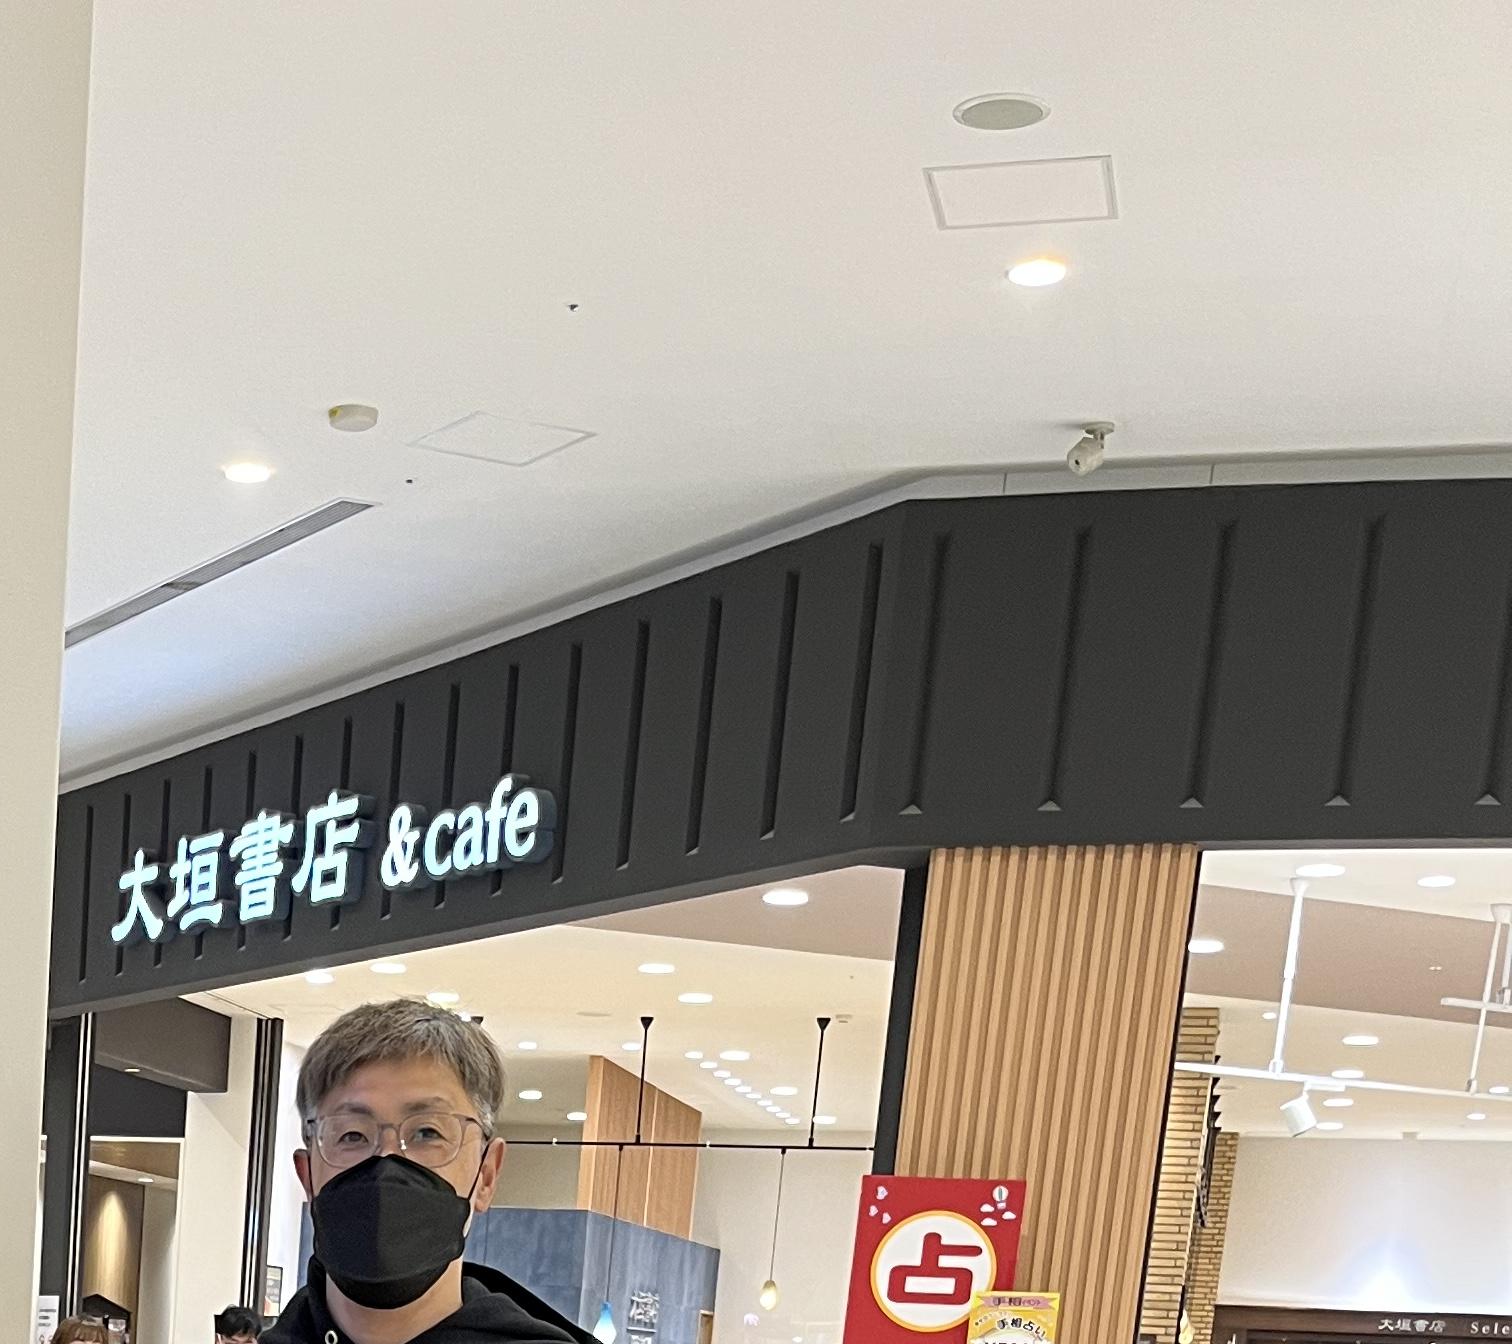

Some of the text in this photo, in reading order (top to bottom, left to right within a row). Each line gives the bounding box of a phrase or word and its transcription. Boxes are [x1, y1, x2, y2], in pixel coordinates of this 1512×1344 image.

[111, 773, 540, 943] 大垣書店 &cafe
[887, 1232, 983, 1305] 占
[1377, 1319, 1446, 1333] 大垣書店
